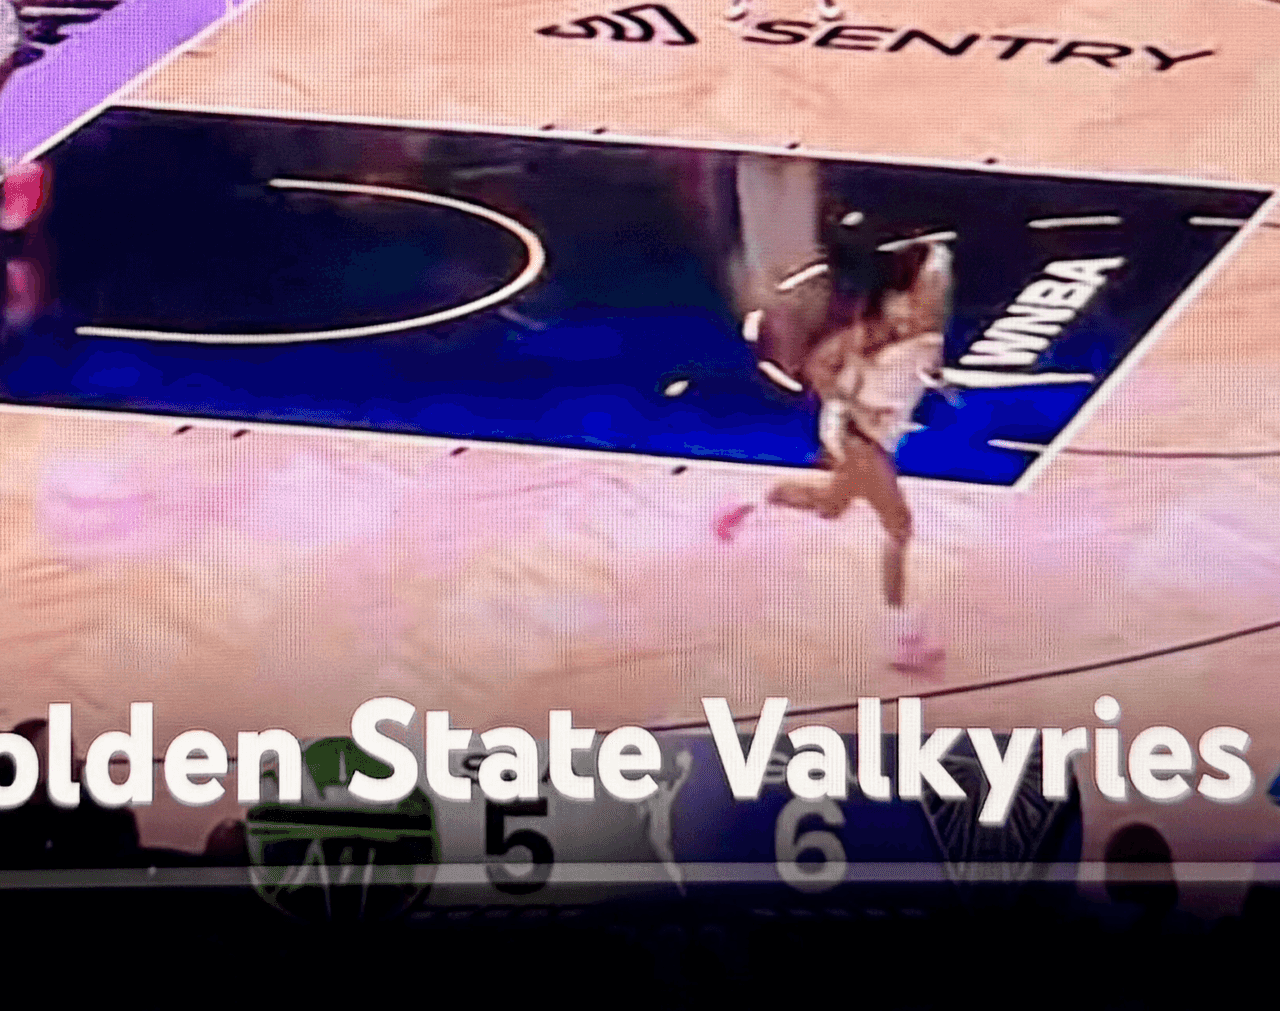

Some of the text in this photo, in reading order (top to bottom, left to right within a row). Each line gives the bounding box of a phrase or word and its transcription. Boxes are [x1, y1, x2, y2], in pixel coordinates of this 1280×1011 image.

[742, 17, 1218, 71] SENTRY
[958, 255, 1128, 367] WNBA
[348, 696, 662, 802] State
[701, 693, 1254, 827] Valkyries
[484, 794, 848, 895] 5 6
